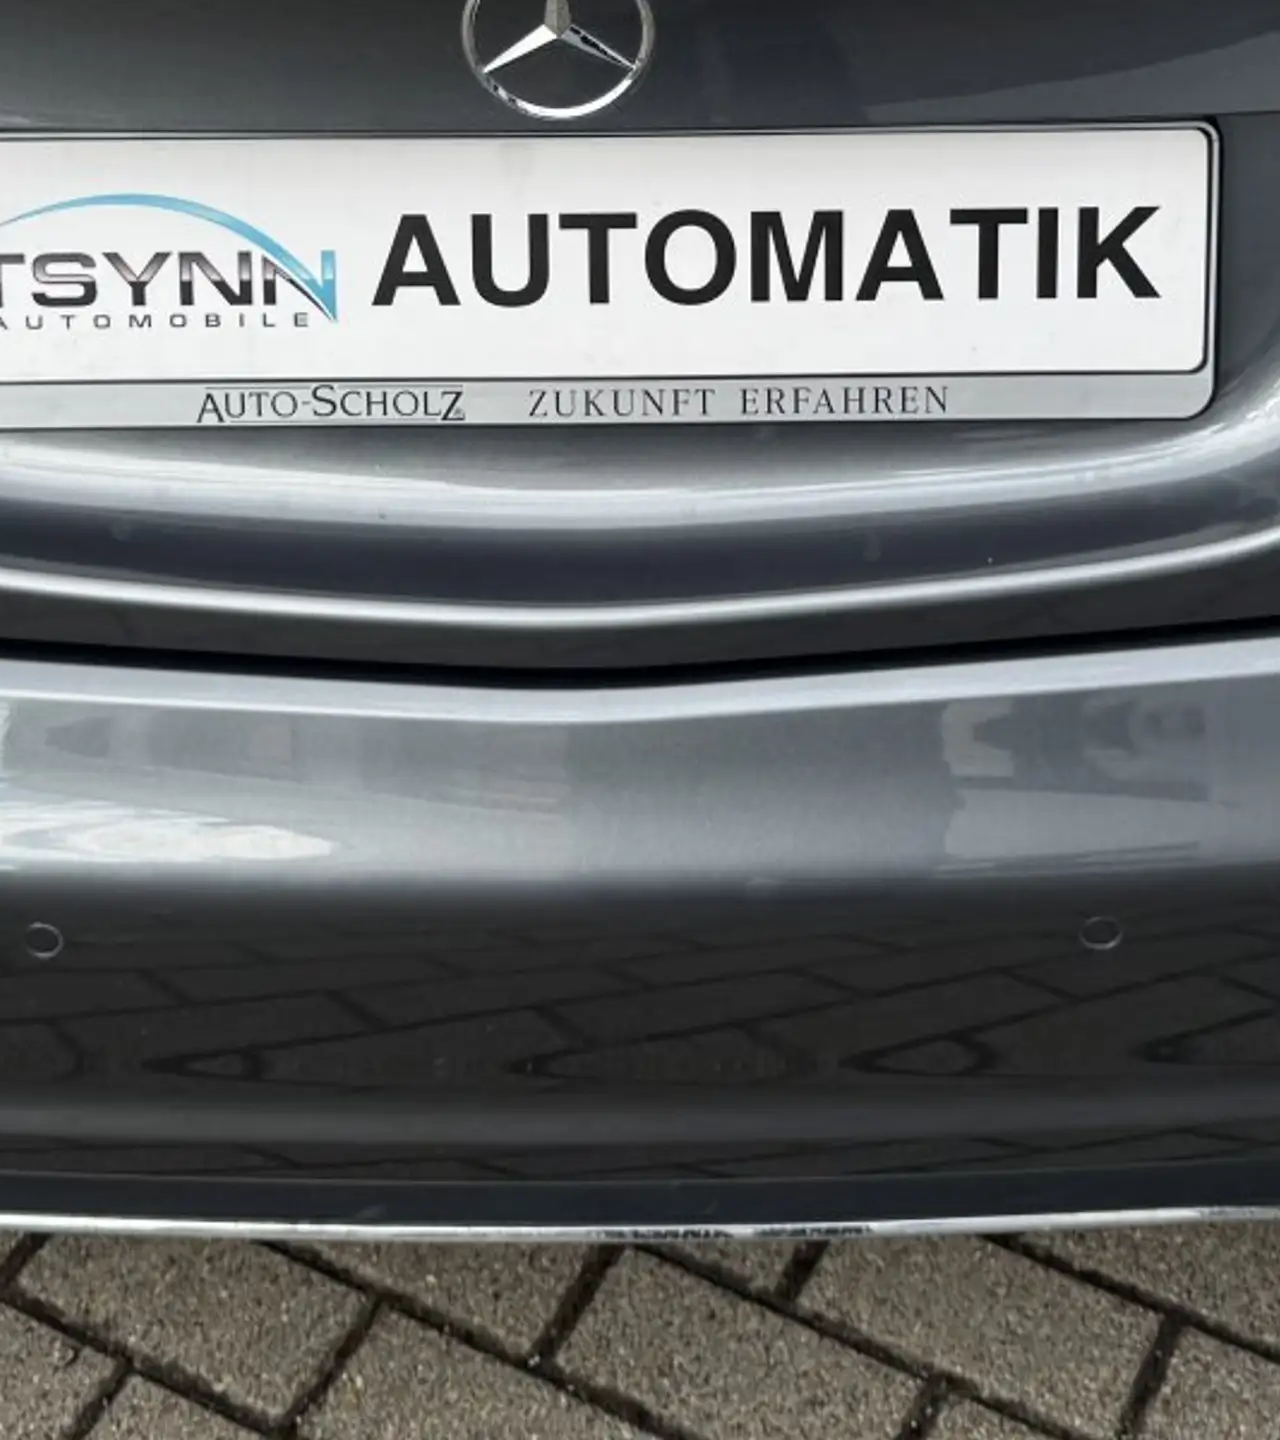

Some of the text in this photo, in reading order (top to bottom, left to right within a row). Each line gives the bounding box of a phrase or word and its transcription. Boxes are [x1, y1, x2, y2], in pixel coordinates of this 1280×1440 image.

[371, 206, 1161, 308] AUTOMATIK
[528, 388, 717, 418] ZUKUNFT
[739, 386, 950, 416] ERFAHREN
